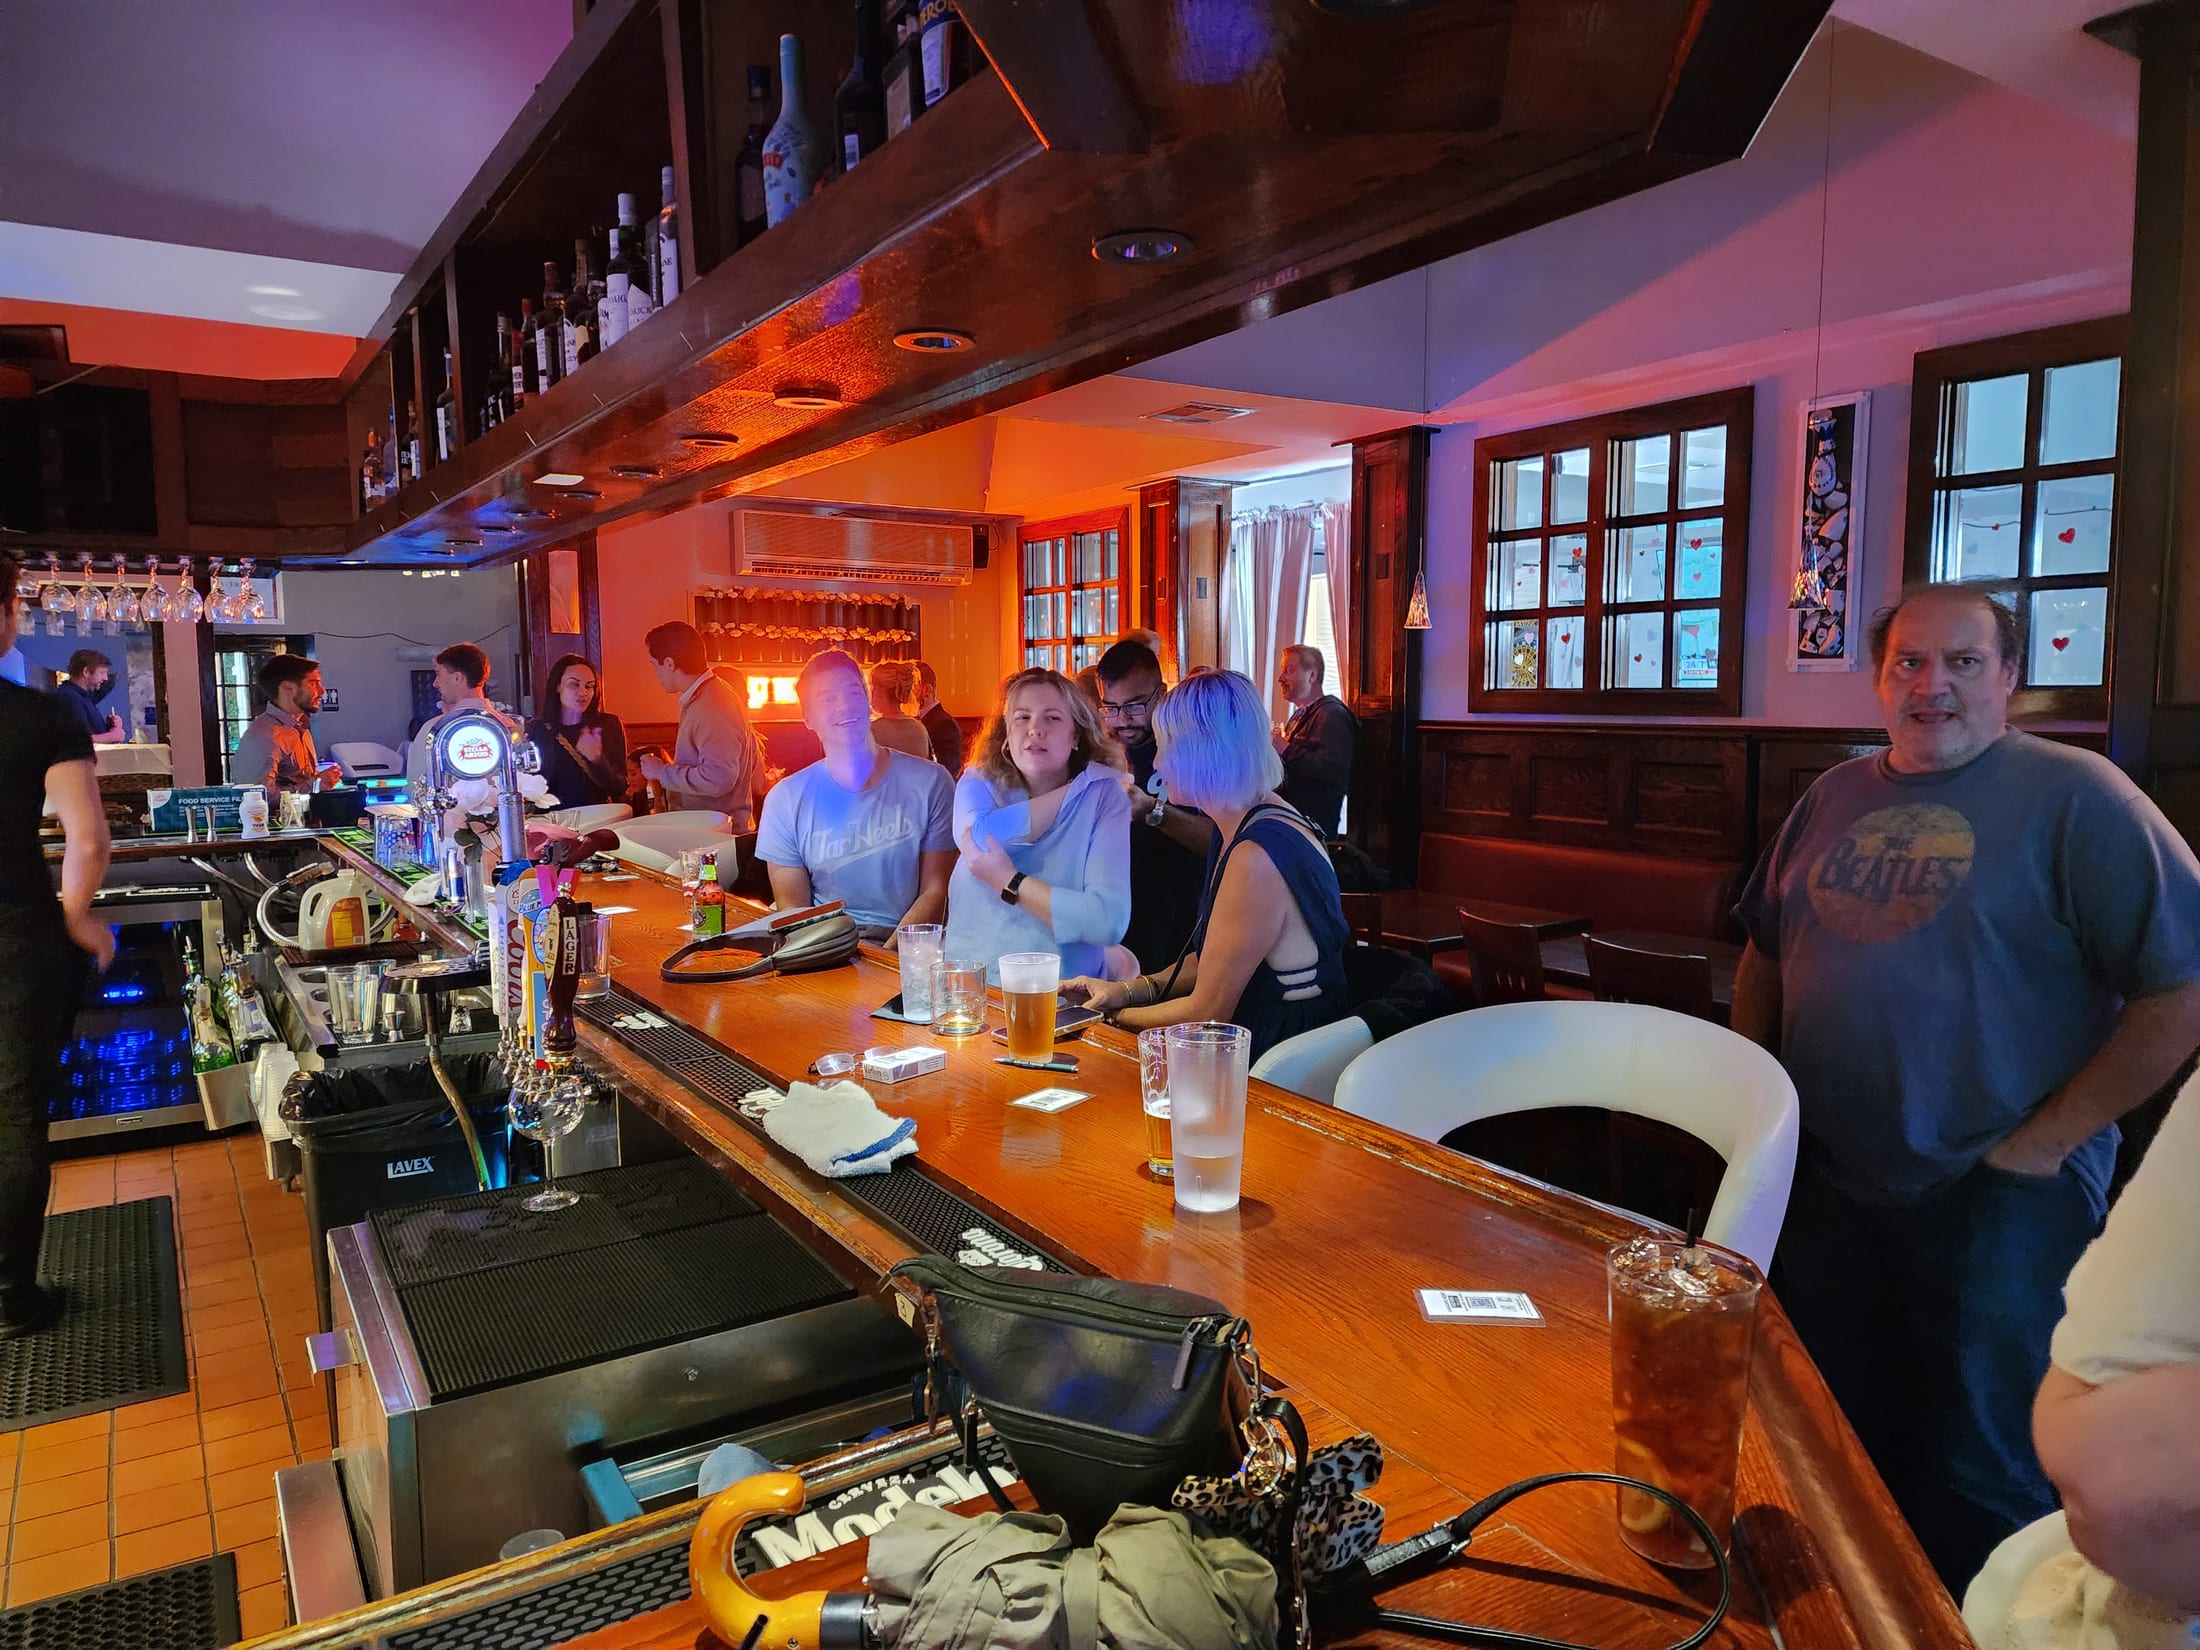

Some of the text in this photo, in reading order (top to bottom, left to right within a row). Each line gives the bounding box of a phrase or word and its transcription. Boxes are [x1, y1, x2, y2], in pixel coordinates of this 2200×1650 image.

[811, 804, 914, 864] Tar Heels
[1816, 837, 1967, 904] BEATLES
[519, 902, 536, 912] BLUE
[564, 918, 575, 974] LAGER
[387, 1156, 435, 1179] LAVEX
[827, 1473, 917, 1511] CERVEZA
